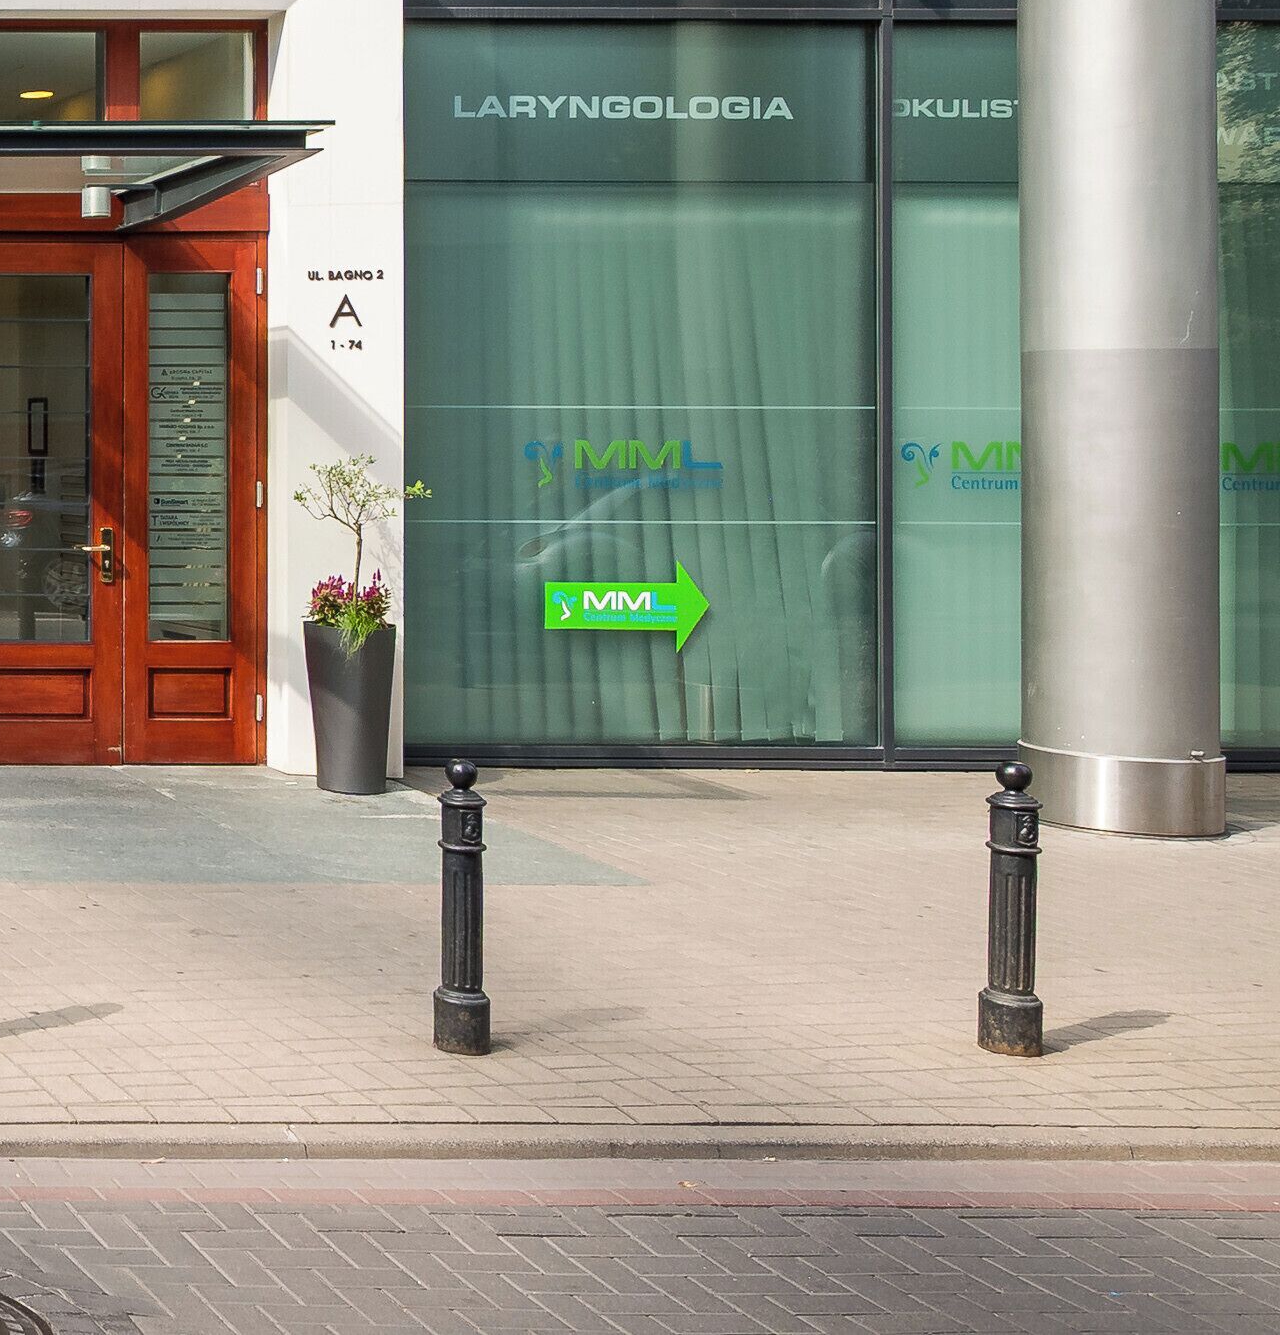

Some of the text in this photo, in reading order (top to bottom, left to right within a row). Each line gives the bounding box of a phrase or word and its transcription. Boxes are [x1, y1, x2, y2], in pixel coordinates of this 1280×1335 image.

[454, 95, 794, 120] LARYNGOLOGIA
[892, 98, 1018, 118] OKULIS
[307, 269, 385, 281] UL. BAGNO 2
[329, 293, 363, 328] A
[330, 339, 336, 351] 1
[348, 339, 363, 351] 74
[575, 439, 724, 470] MML
[951, 475, 1018, 490] Centrum
[583, 590, 676, 611] MML
